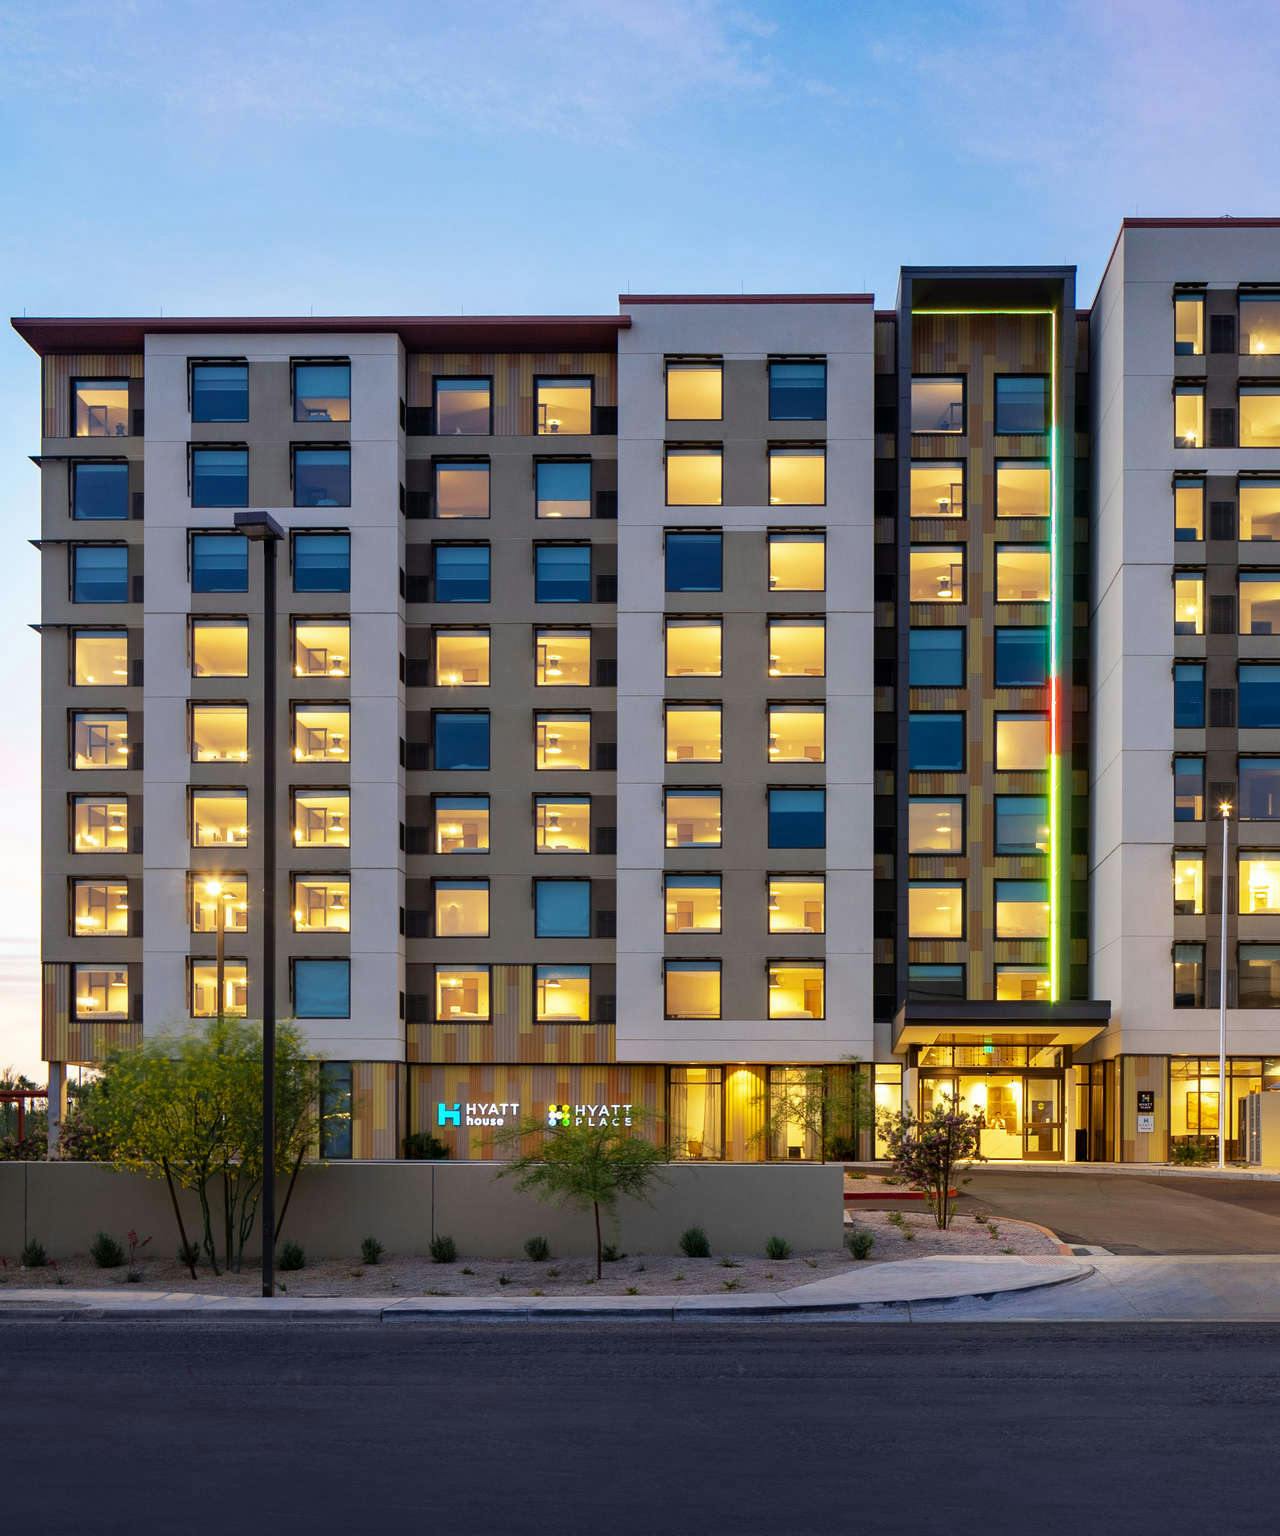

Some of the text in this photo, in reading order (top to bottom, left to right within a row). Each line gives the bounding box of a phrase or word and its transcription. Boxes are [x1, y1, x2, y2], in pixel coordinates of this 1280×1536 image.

[466, 1103, 520, 1115] HYATT
[575, 1104, 633, 1117] HYATT
[466, 1116, 504, 1126] house
[575, 1117, 632, 1127] PLACE
